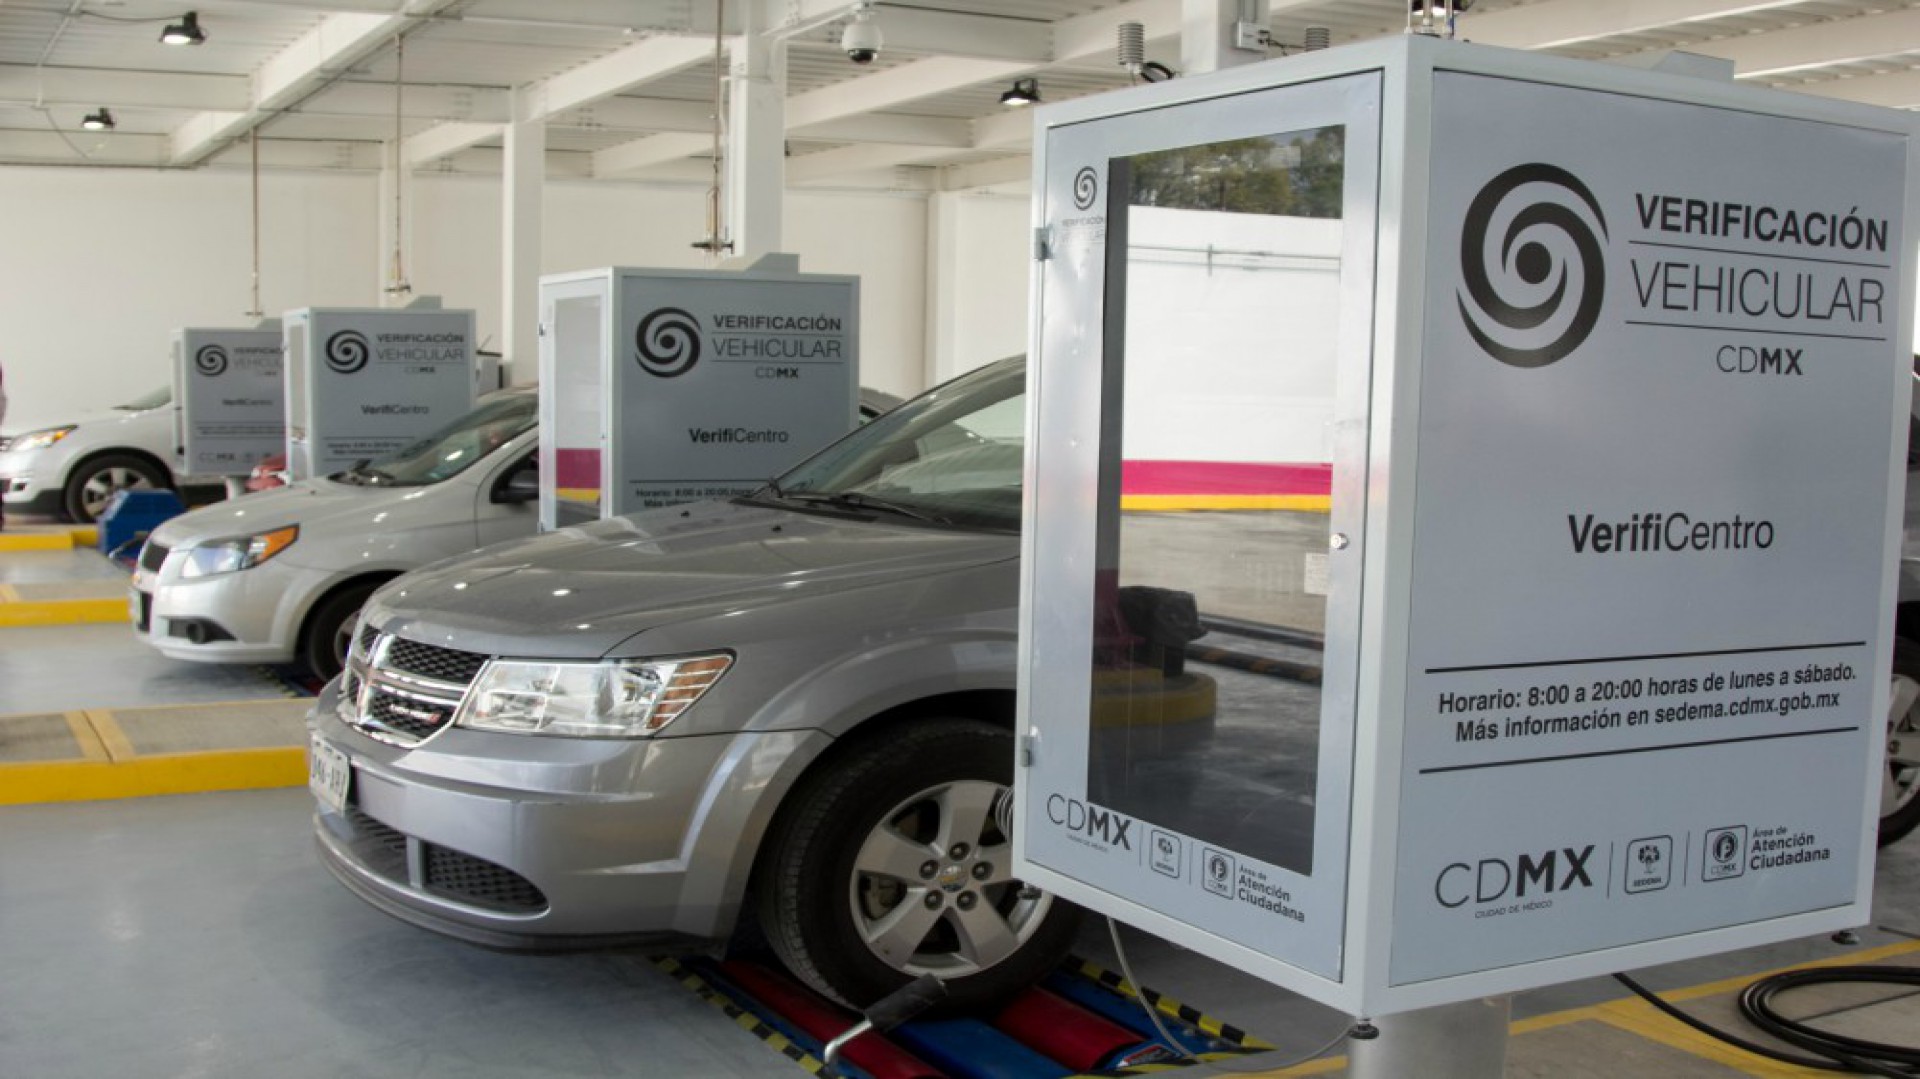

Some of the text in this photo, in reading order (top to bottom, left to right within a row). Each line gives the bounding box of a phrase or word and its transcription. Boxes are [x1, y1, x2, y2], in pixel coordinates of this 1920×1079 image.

[1635, 193, 1888, 251] VERIFICACIÓN
[1631, 258, 1885, 323] VEHICULAR
[712, 313, 842, 330] VERIFICACIÓN
[711, 338, 842, 358] VEHICULAR
[1716, 345, 1804, 375] CDMX
[755, 367, 799, 379] CDMX
[688, 428, 790, 443] VerifiCentro
[1568, 512, 1774, 553] VerifiCentro
[1439, 663, 1857, 714] Horario: 8:00 a 20:00 horas de lunes a sábado.
[1455, 691, 1840, 743] Más información en sedema.cdmx.gob.mx
[1046, 793, 1132, 851] CDMX
[1752, 825, 1788, 838] Área de
[1751, 833, 1815, 853] Atención
[1749, 847, 1831, 871] Ciudadana
[1238, 874, 1291, 902] Atención
[1434, 844, 1595, 908] CDMX
[1238, 887, 1305, 922] Ciudadana
